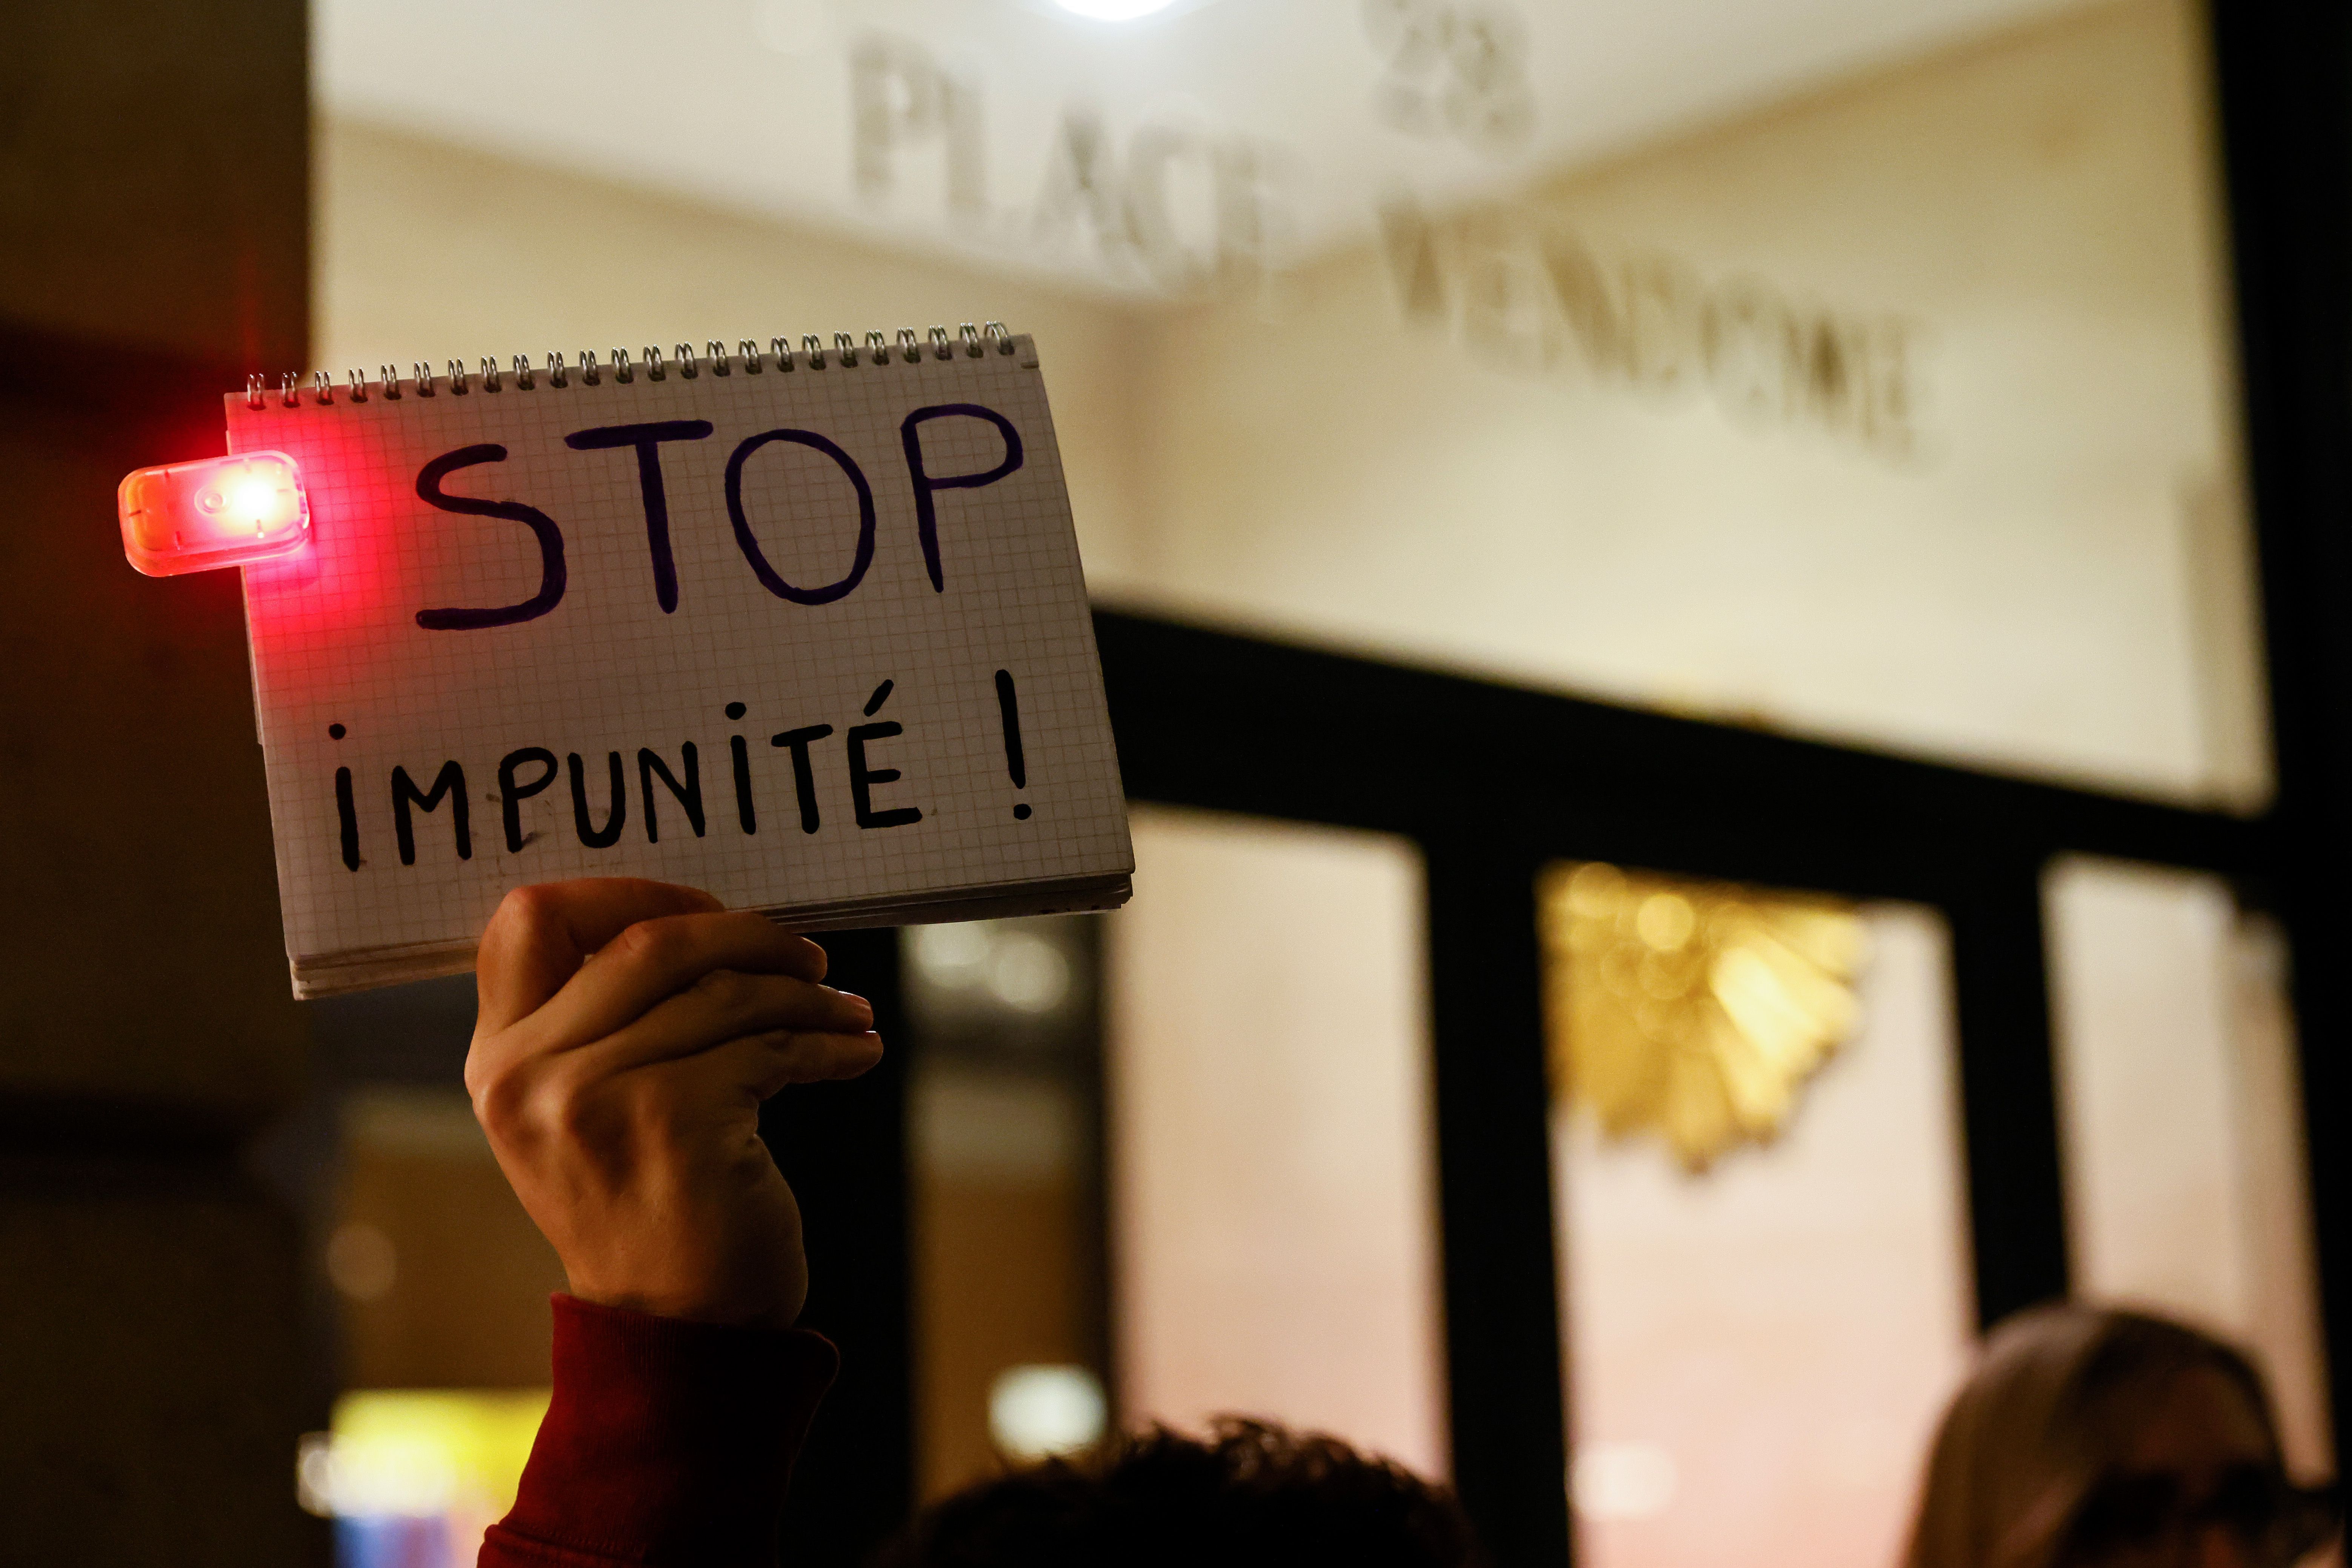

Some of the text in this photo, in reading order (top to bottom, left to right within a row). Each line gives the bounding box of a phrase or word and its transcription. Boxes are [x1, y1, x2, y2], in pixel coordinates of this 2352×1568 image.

[845, 26, 1302, 313] PLACE
[415, 403, 1024, 631] STOP
[994, 669, 1033, 821] !
